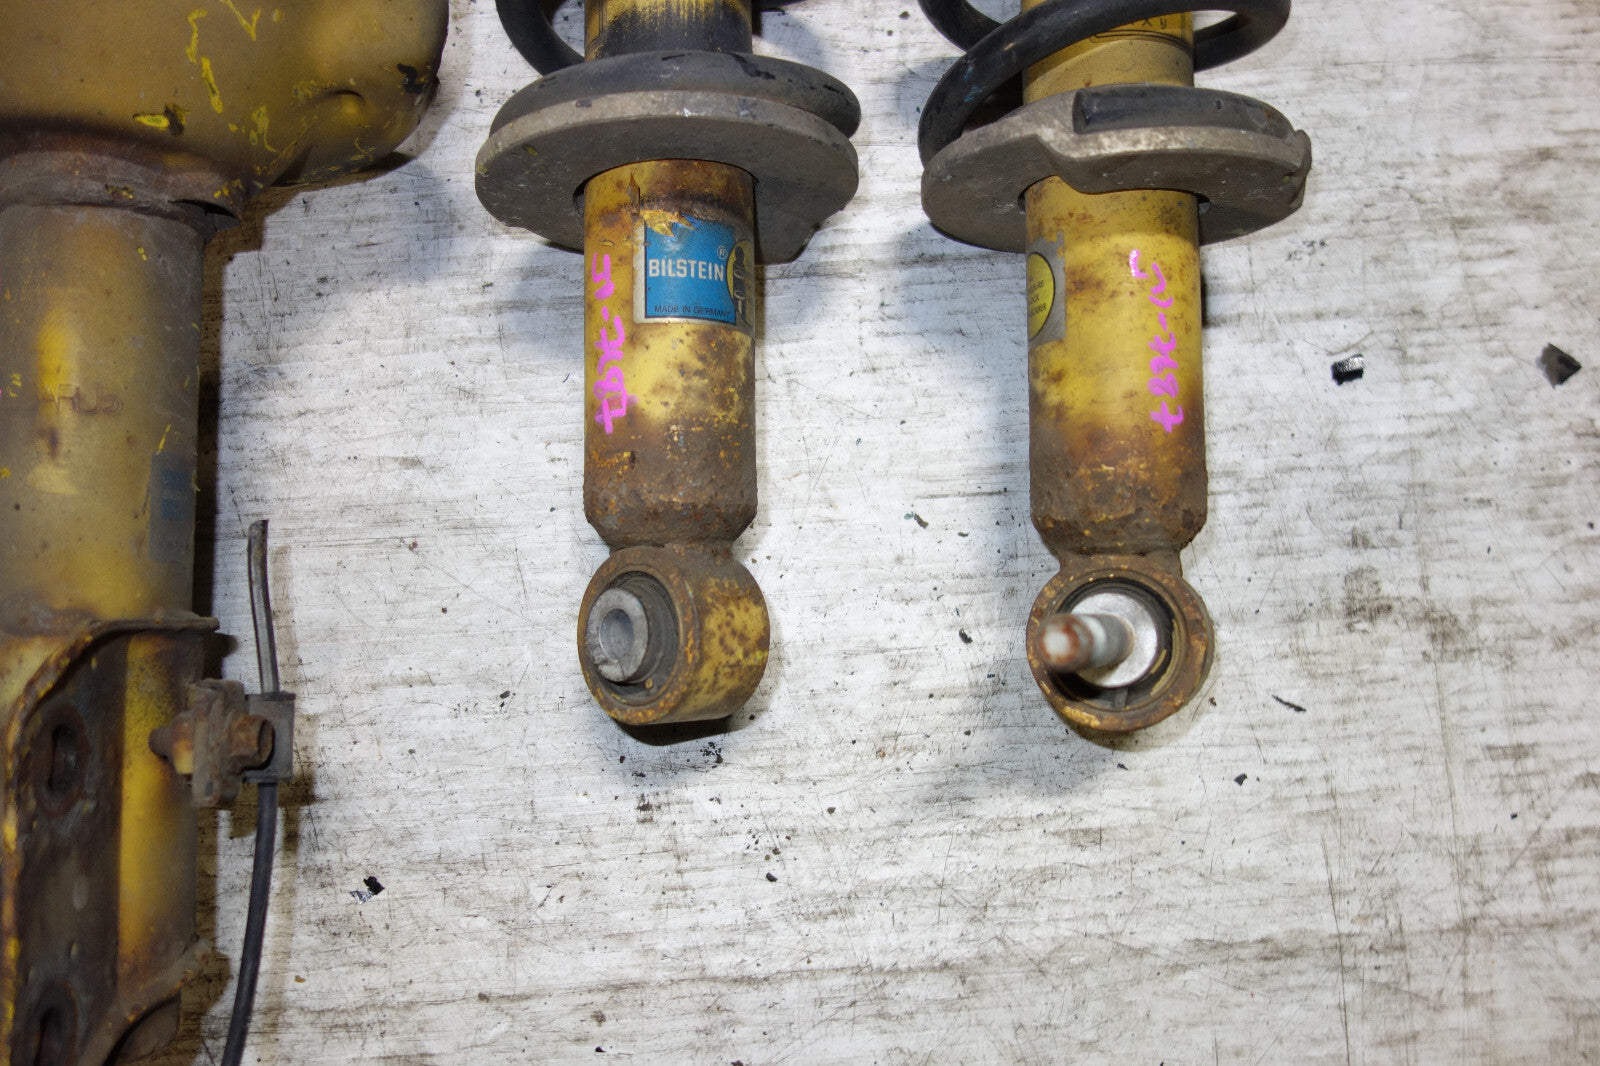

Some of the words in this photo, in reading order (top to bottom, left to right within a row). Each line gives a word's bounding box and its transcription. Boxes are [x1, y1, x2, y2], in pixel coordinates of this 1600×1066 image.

[648, 258, 724, 282] BILSTEIN
[655, 305, 678, 313] MADE
[694, 306, 731, 318] GERMANY
